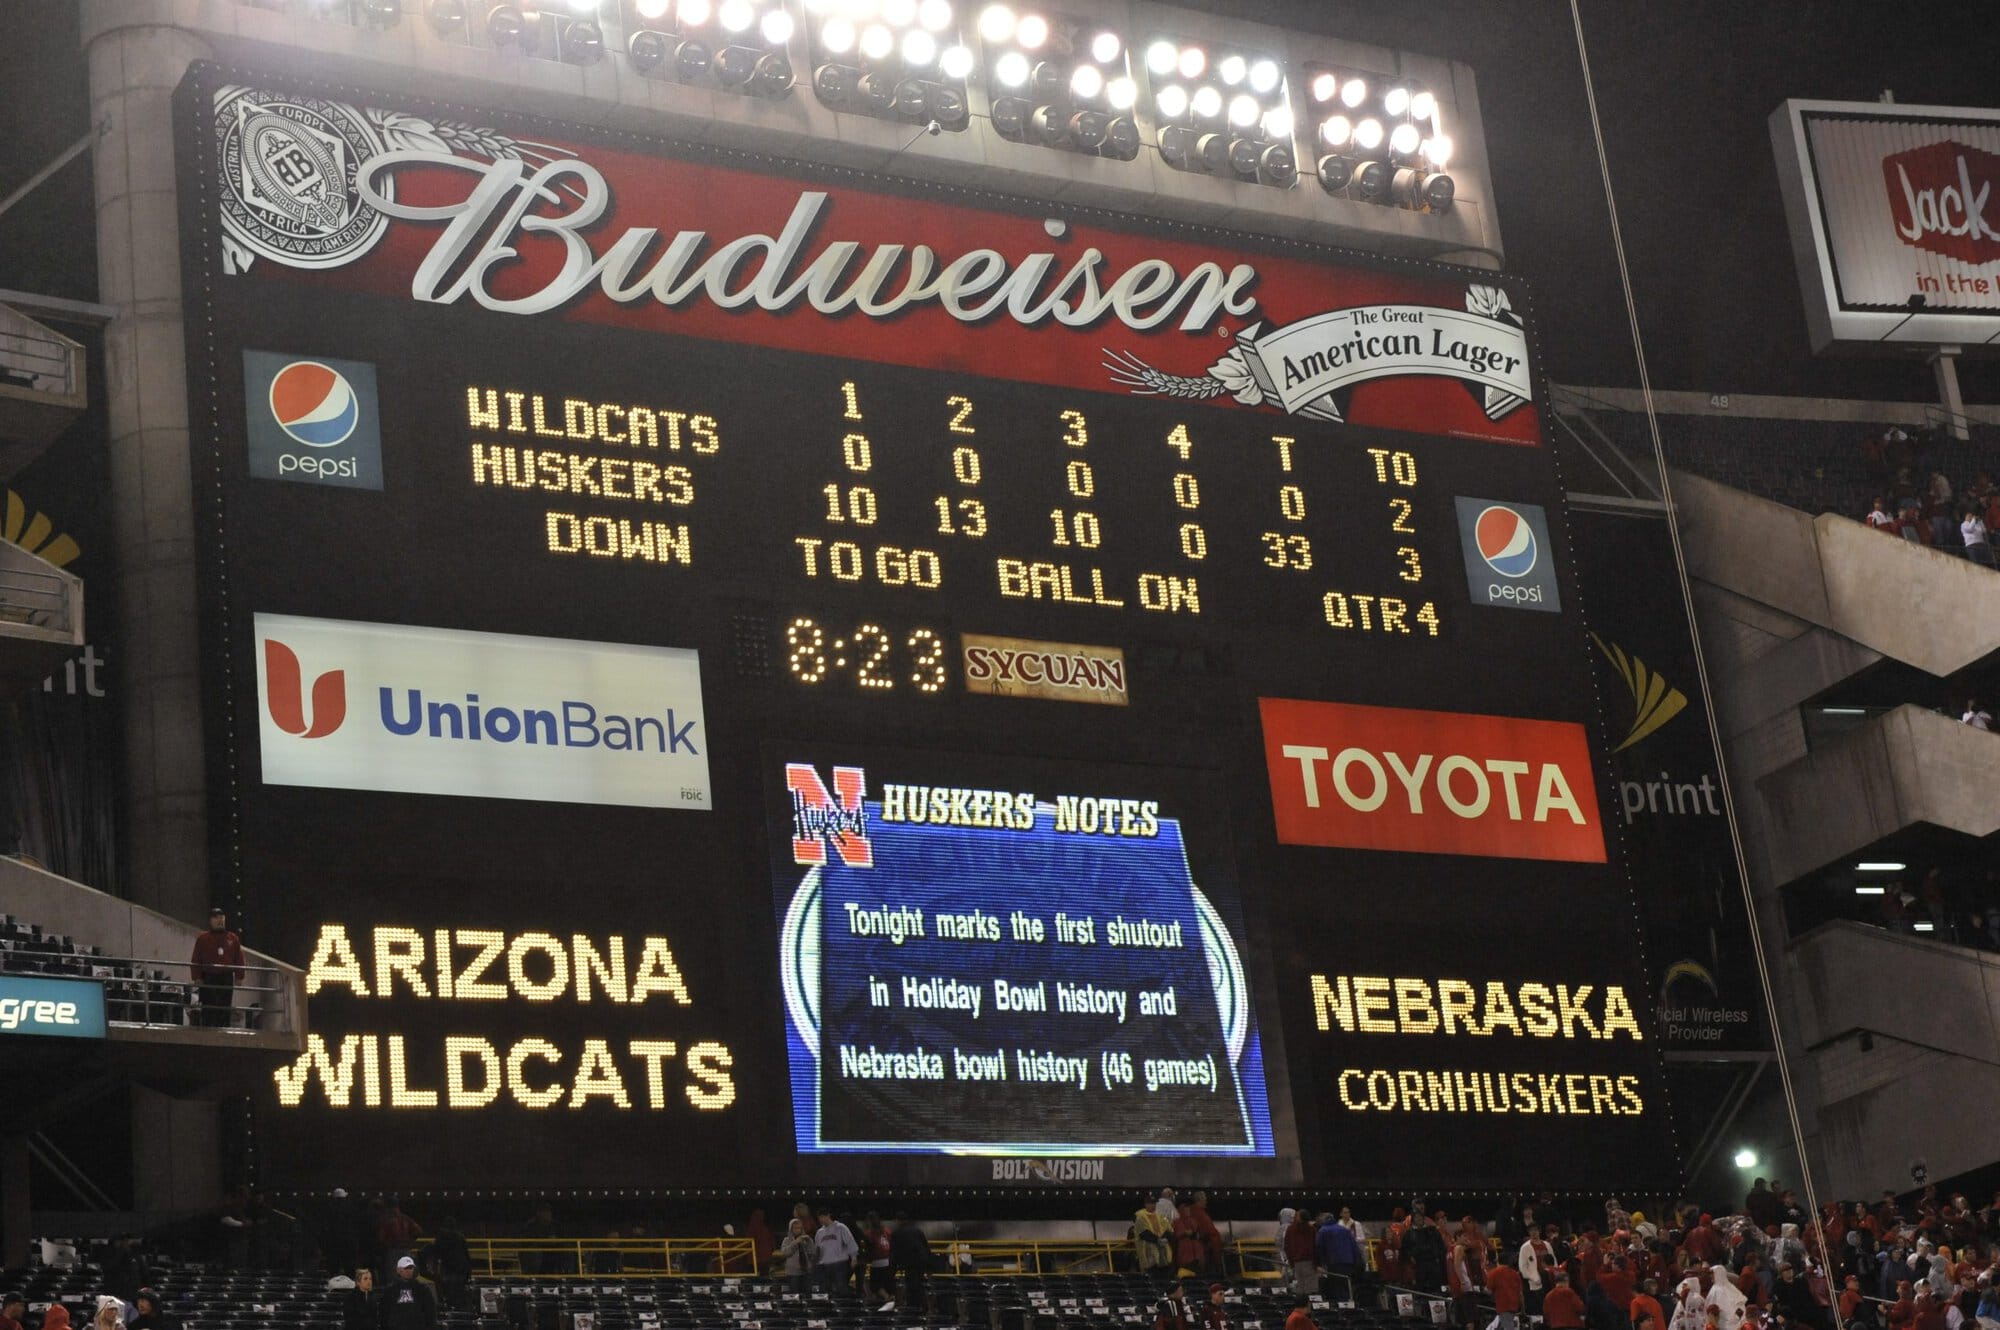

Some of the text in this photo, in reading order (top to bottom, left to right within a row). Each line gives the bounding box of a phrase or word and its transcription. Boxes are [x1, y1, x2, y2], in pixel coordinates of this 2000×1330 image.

[278, 106, 325, 132] EUROPE
[227, 135, 241, 189] AUSTRALIA
[347, 162, 359, 194] ASIA
[258, 208, 308, 235] AFRICA
[1895, 154, 2000, 242] Jack
[323, 218, 367, 251] AMERICA
[356, 150, 1257, 332] Budweiser
[1916, 272, 1940, 293] in
[1946, 273, 1989, 294] the
[1350, 307, 1424, 326] The Great
[1282, 328, 1521, 391] American Lager
[841, 382, 1418, 487] 1 2 3 4 T TO
[278, 455, 358, 480] pepsi
[467, 387, 1415, 534] WILDCATS 0 0 0 0 0 2
[472, 443, 1422, 582] HUSKERS 10 13 10 0 33 3
[546, 512, 692, 565] DOWN
[795, 538, 862, 581] TO
[875, 547, 942, 589] GO
[997, 559, 1124, 606] BALL
[1138, 574, 1201, 614] ON
[1488, 582, 1542, 604] pepsi
[787, 619, 946, 692] 8:23
[966, 646, 1125, 692] SYCUAN
[379, 686, 699, 756] UnionBank
[680, 791, 704, 801] FDIC
[1283, 744, 1587, 825] TOYOTA
[882, 783, 1160, 838] HUSKERS NOTES
[844, 902, 1183, 949] Tonight marks the first shutout
[305, 925, 693, 1005] ARIZONA
[870, 976, 1177, 1023] in Holiday Bowl history and
[1311, 975, 1643, 1041] NEBRASKA
[1692, 1007, 1749, 1022] Wireless
[1669, 1024, 1724, 1040] Provider
[274, 1034, 736, 1110] WILDCATS
[840, 1045, 1218, 1092] Nebraska bowl history (46 games)
[1338, 1070, 1644, 1115] CORNHUSKERS
[992, 1159, 1104, 1180] BOLT VISION
